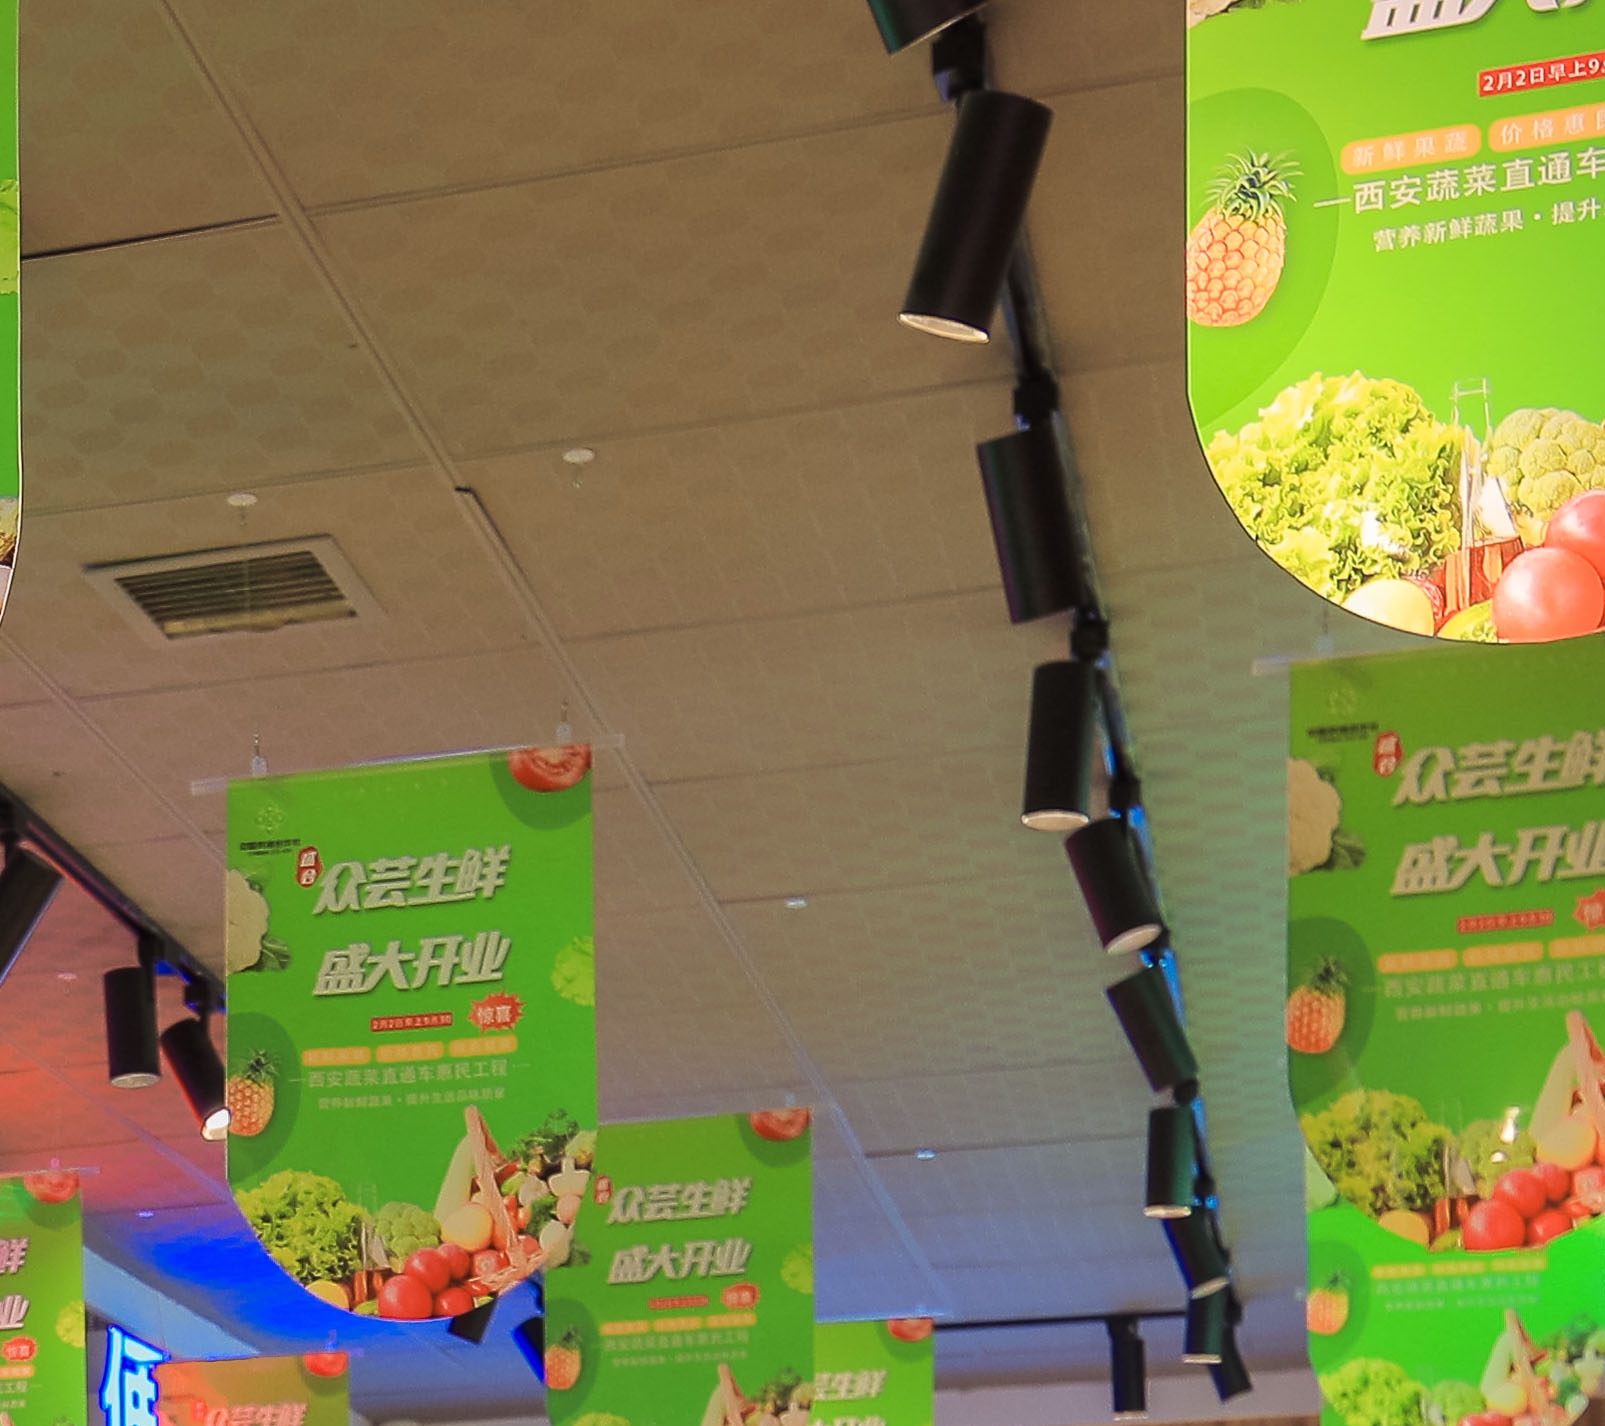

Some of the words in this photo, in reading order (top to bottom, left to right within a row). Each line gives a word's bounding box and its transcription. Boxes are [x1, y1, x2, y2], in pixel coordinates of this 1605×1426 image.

[1353, 134, 1467, 167] 新鲜果蔬
[312, 846, 511, 914] 众芸生鲜
[312, 931, 511, 996] 盛大开业
[477, 1006, 511, 1024] 惊喜
[608, 1177, 753, 1224] 众芸生鲜
[608, 1238, 752, 1284] 盛大开业
